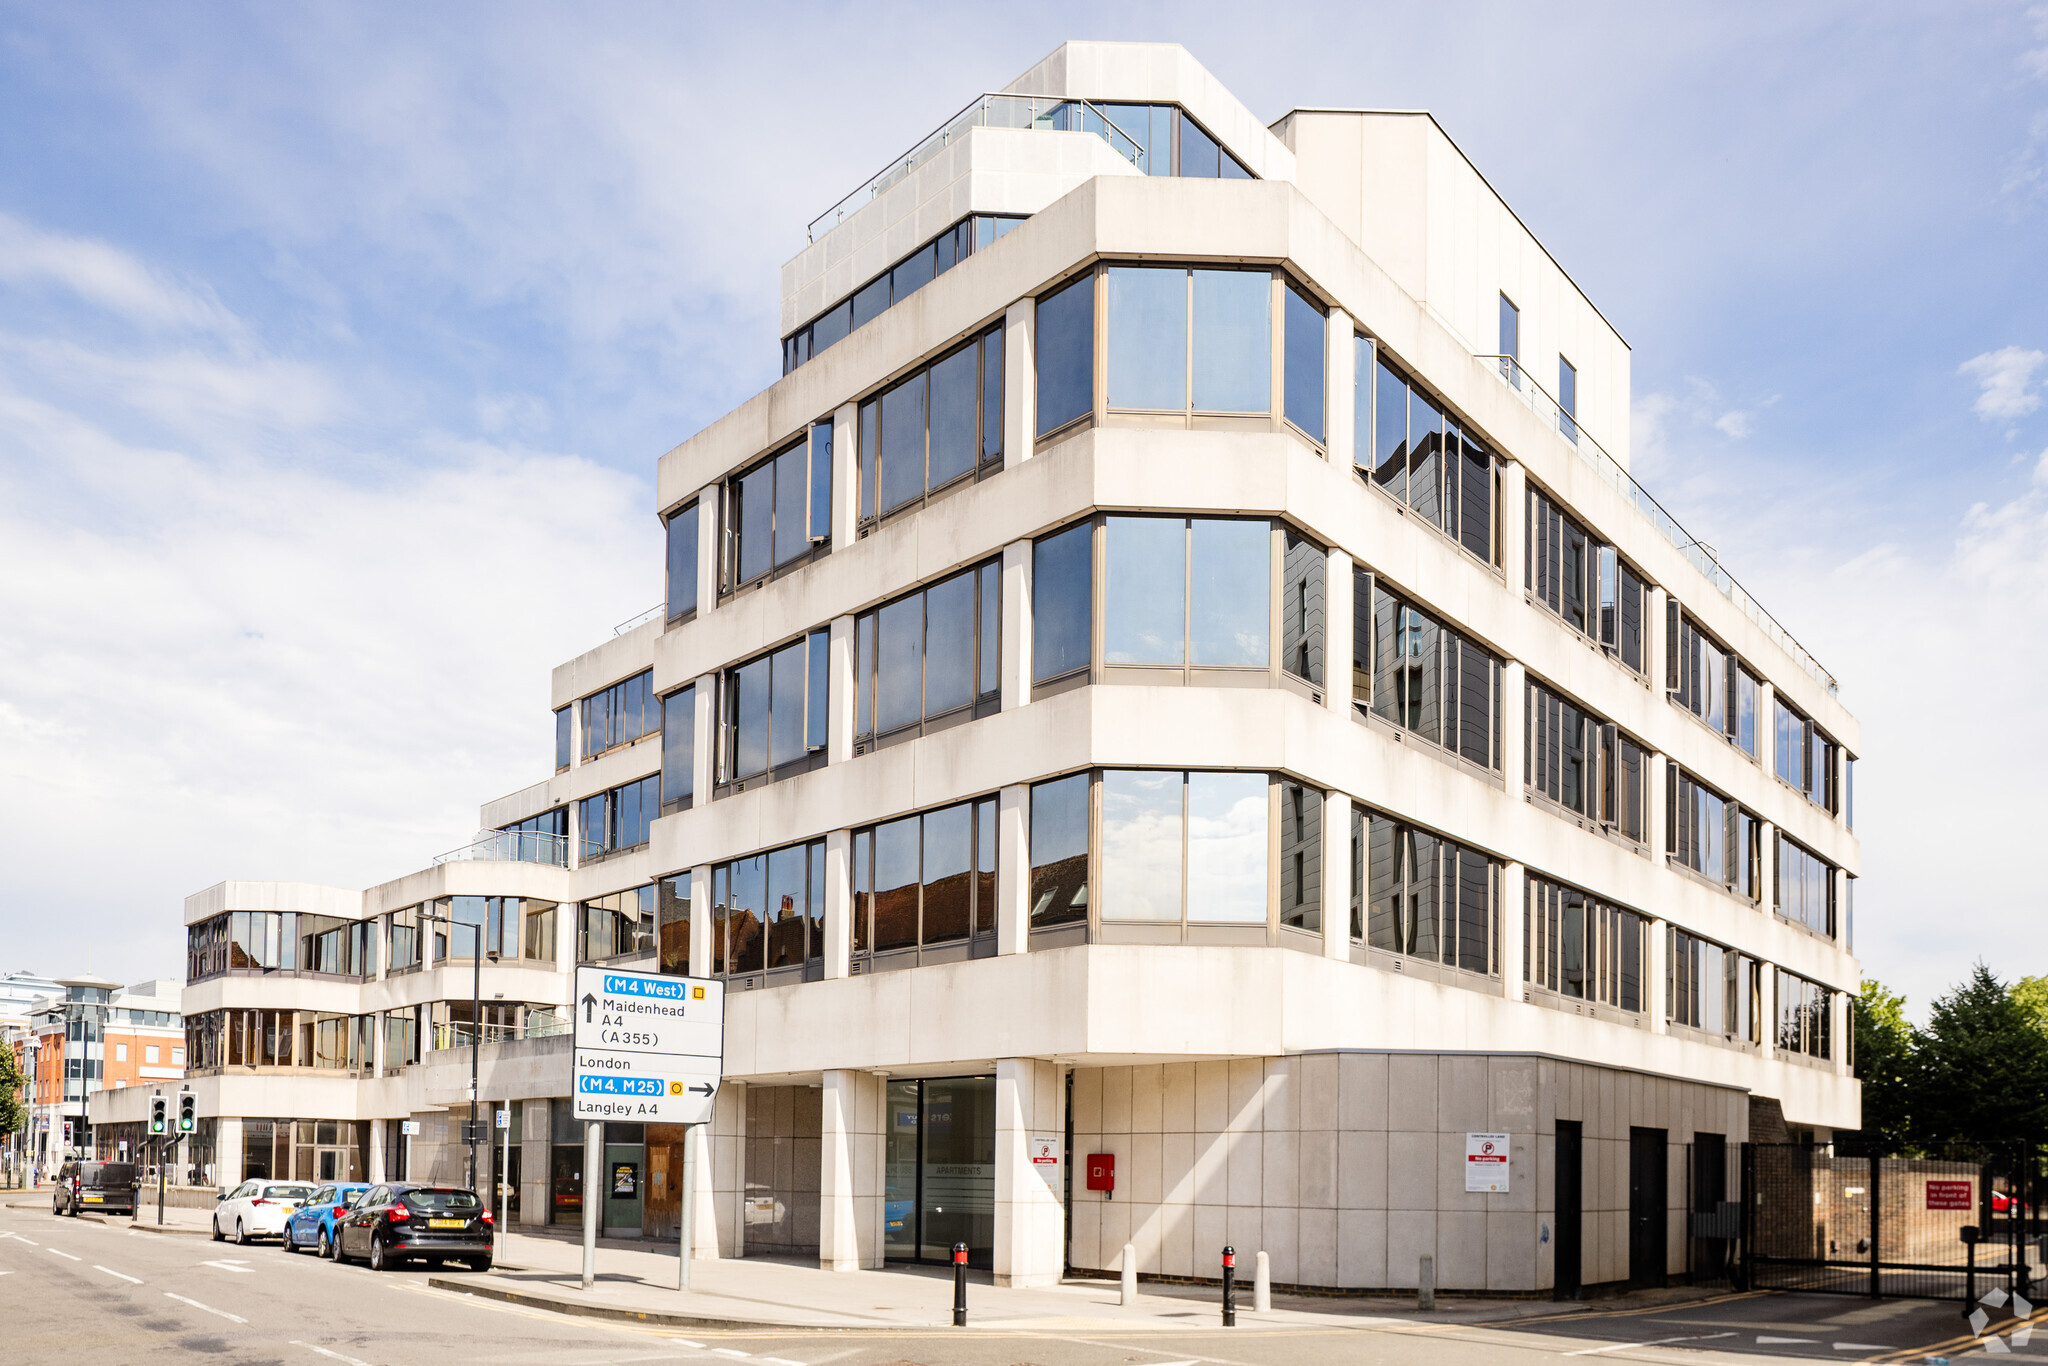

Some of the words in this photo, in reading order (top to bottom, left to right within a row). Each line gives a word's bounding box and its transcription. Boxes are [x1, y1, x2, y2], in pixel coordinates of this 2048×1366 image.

[643, 982, 684, 999] West)
[602, 999, 685, 1017] Maidenhead
[601, 1015, 624, 1027] A4
[601, 1029, 659, 1047] (A355)
[579, 1055, 631, 1070] London
[578, 1100, 632, 1116] Langley
[637, 1103, 659, 1115] A4
[936, 1166, 982, 1176] APARTMENTS
[1941, 1184, 1969, 1192] parking
